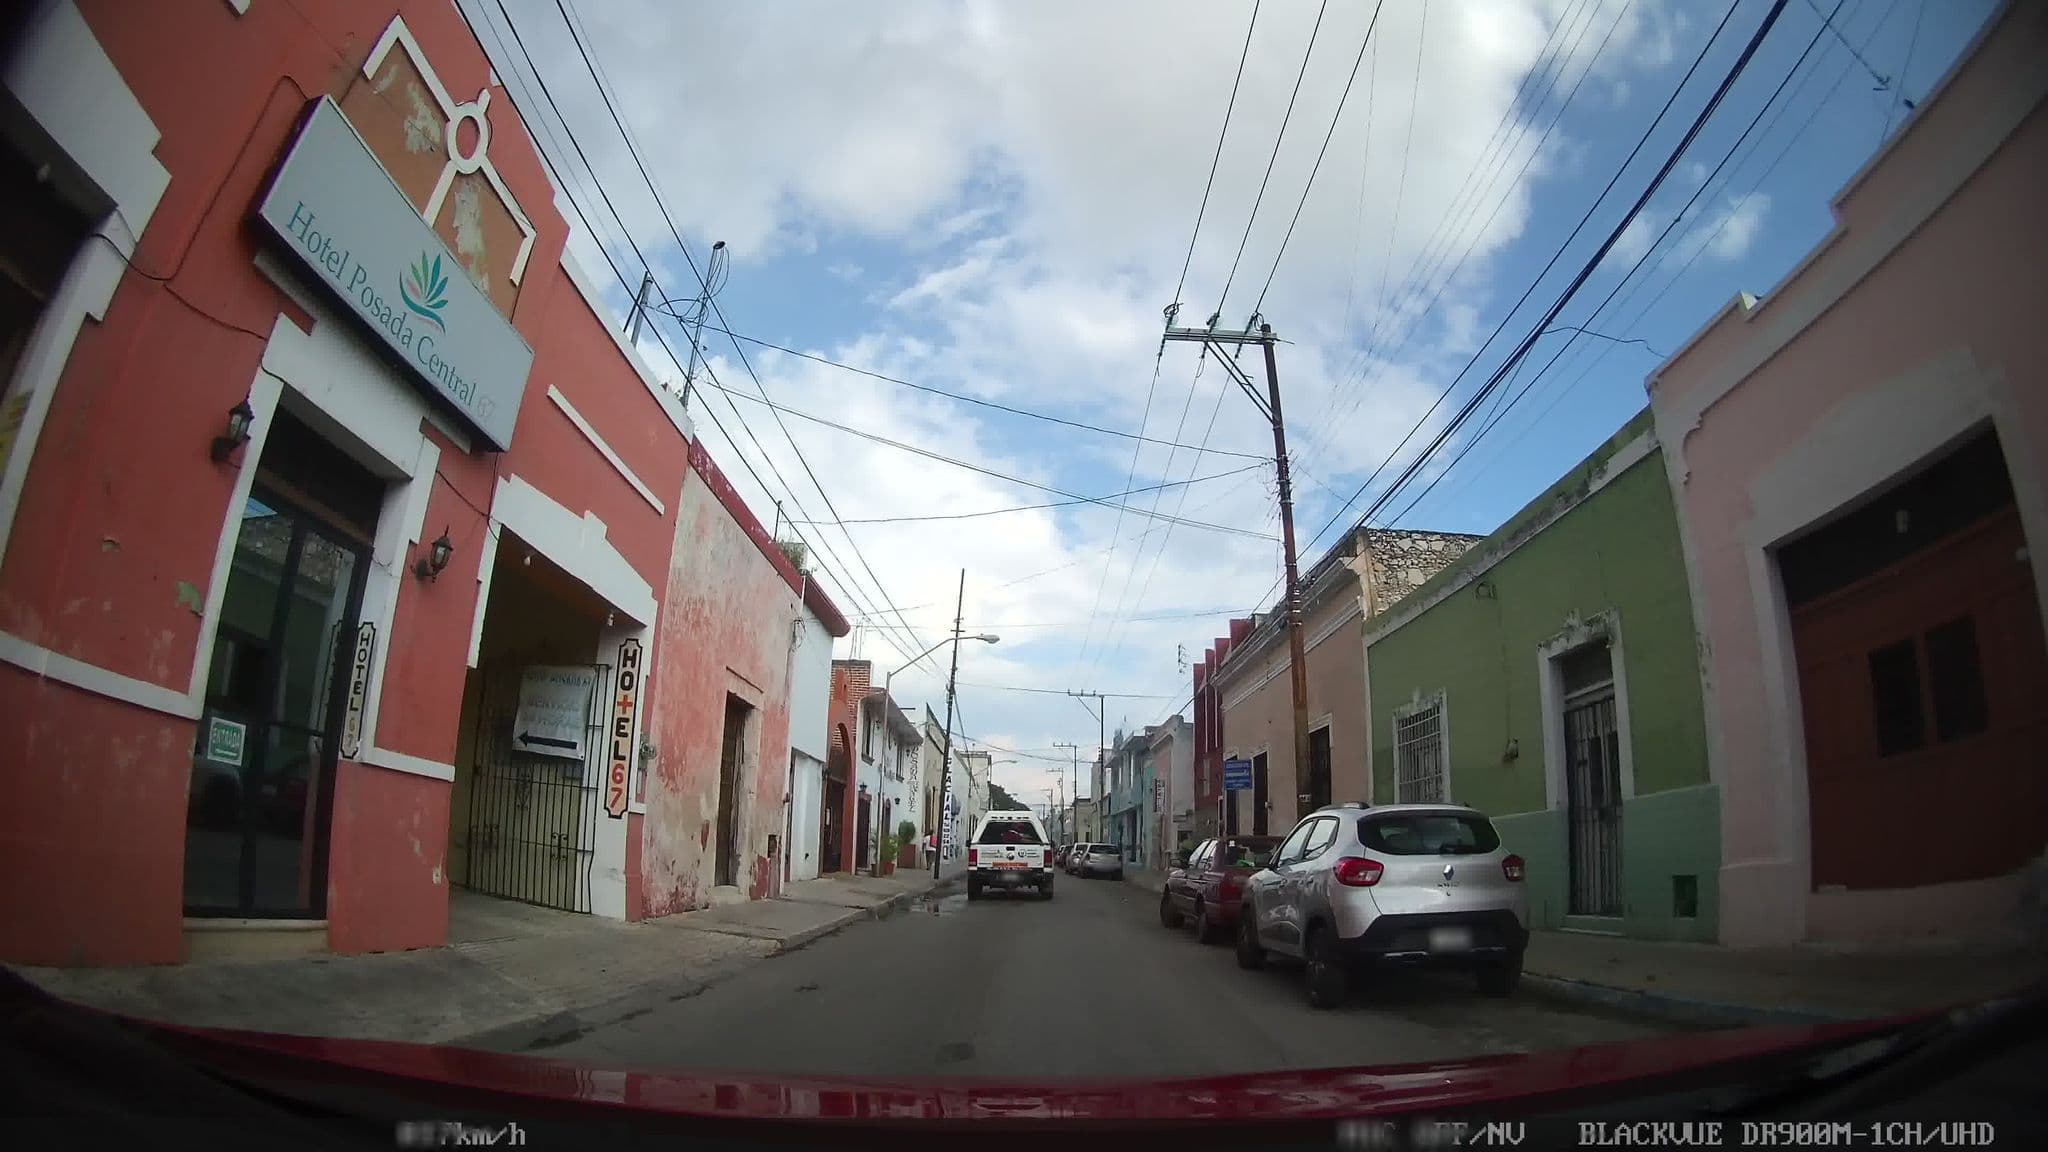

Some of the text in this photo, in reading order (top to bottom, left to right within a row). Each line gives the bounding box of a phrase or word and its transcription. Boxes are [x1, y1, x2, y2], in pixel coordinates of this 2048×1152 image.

[284, 201, 349, 280] Hotel
[346, 262, 414, 349] Posada
[416, 336, 478, 407] Central
[349, 631, 371, 712] HOTEL
